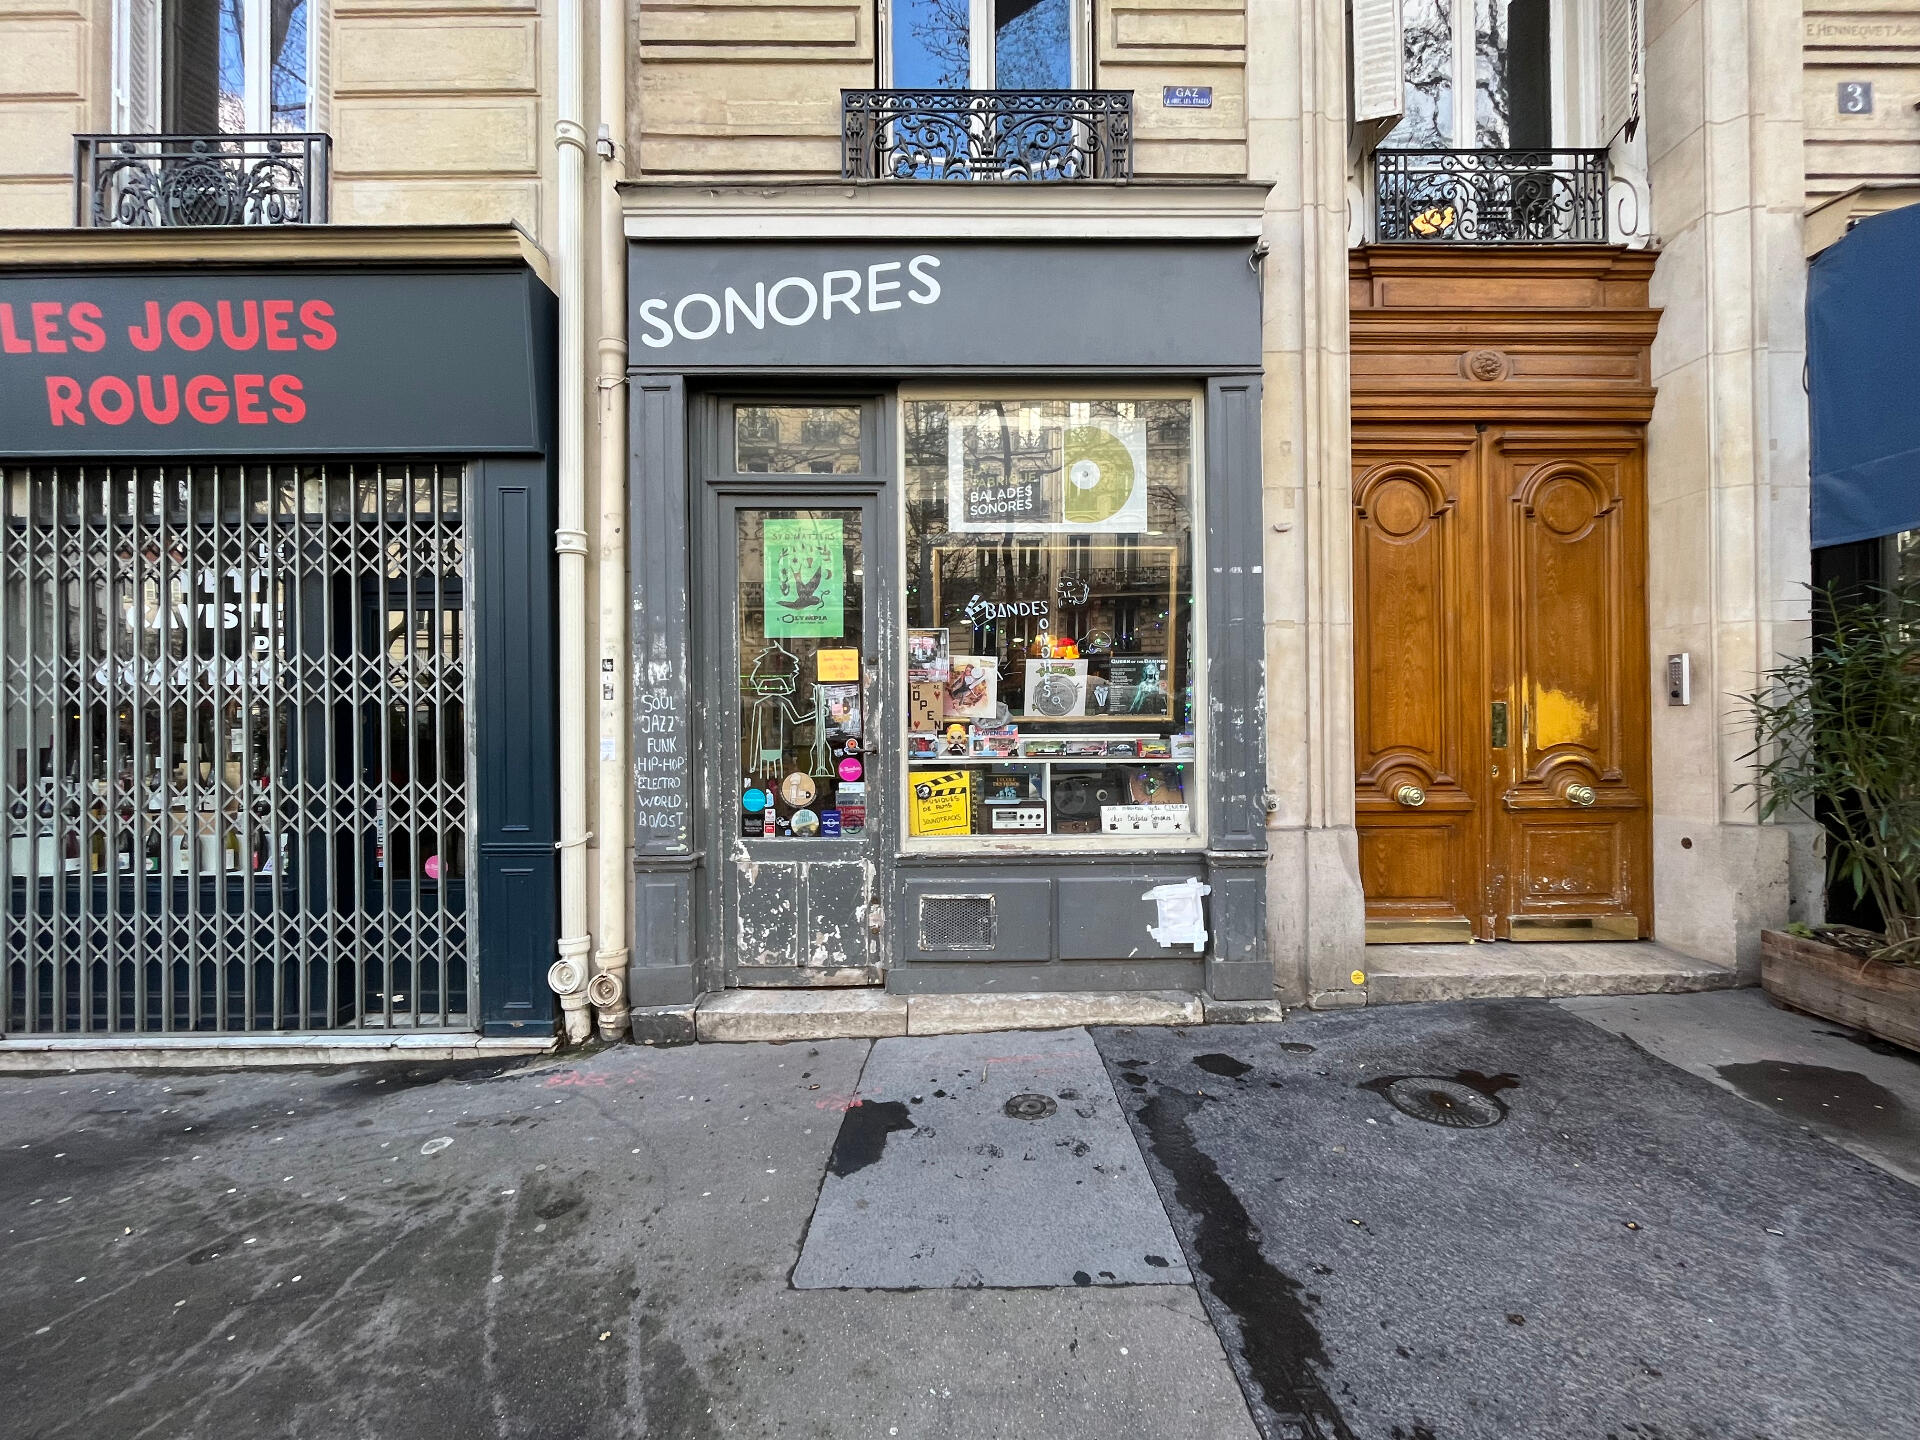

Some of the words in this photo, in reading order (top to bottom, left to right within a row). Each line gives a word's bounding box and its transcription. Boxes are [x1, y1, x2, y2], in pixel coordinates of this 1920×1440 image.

[1175, 88, 1199, 97] GAZ
[1847, 83, 1863, 112] 3
[639, 254, 941, 348] SONORES
[0, 302, 107, 353] LES
[127, 300, 338, 352] JOUES
[45, 374, 306, 426] ROUGES
[970, 485, 1033, 503] BALADES
[970, 499, 1033, 516] SONORES
[126, 603, 285, 629] CAVISTE
[985, 600, 1049, 620] BANDES
[642, 694, 677, 713] SOUL
[912, 690, 941, 730] OPEN
[641, 714, 675, 734] JAZZ
[647, 736, 677, 754] FUNK
[637, 756, 685, 772] HIP-HOP
[637, 776, 681, 790] ELECTRO
[638, 794, 682, 809] WORLD
[922, 814, 961, 826] SOUNDTRACKS
